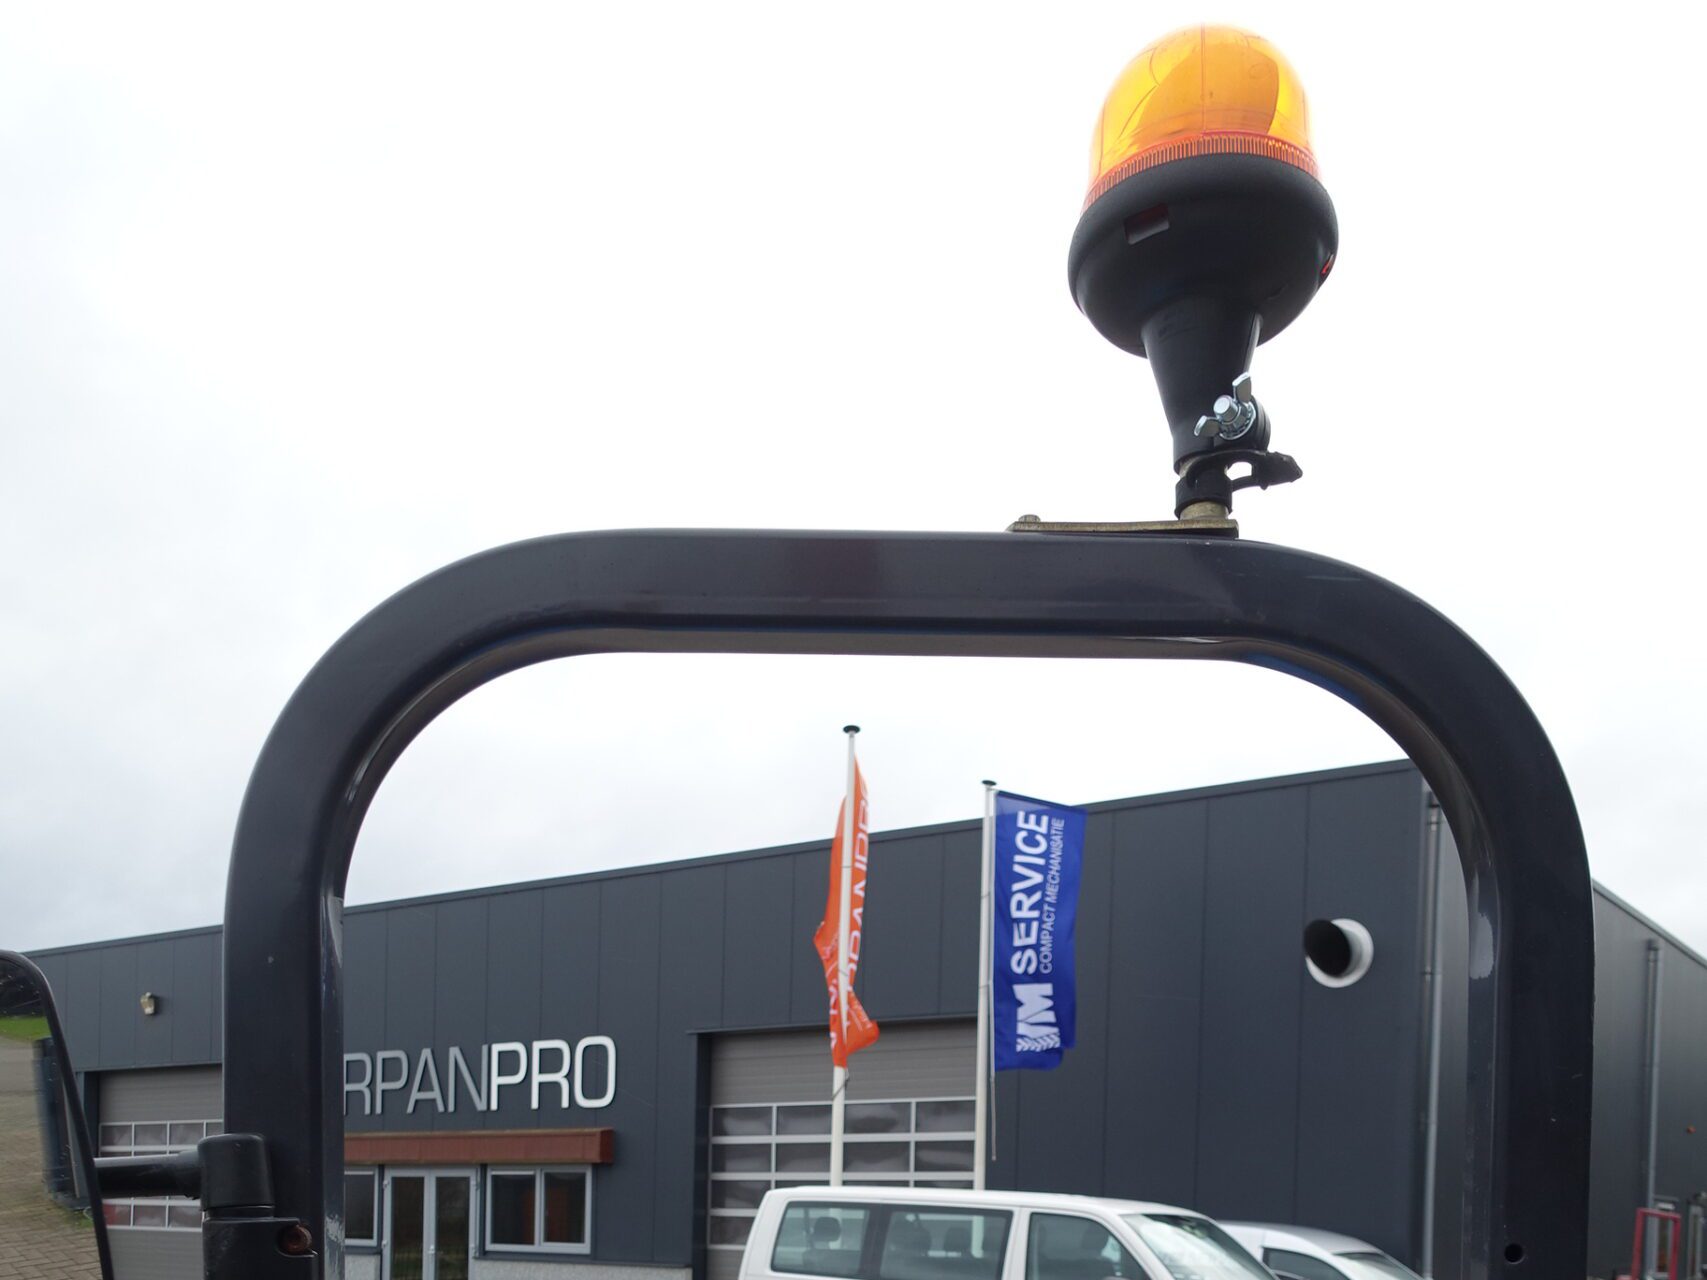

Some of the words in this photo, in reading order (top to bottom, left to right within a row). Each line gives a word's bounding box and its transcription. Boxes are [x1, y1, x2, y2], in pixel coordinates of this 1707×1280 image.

[1010, 811, 1048, 974] SERVICE
[1044, 817, 1065, 903] MECHANISATIE
[1039, 903, 1056, 974] COMPACT
